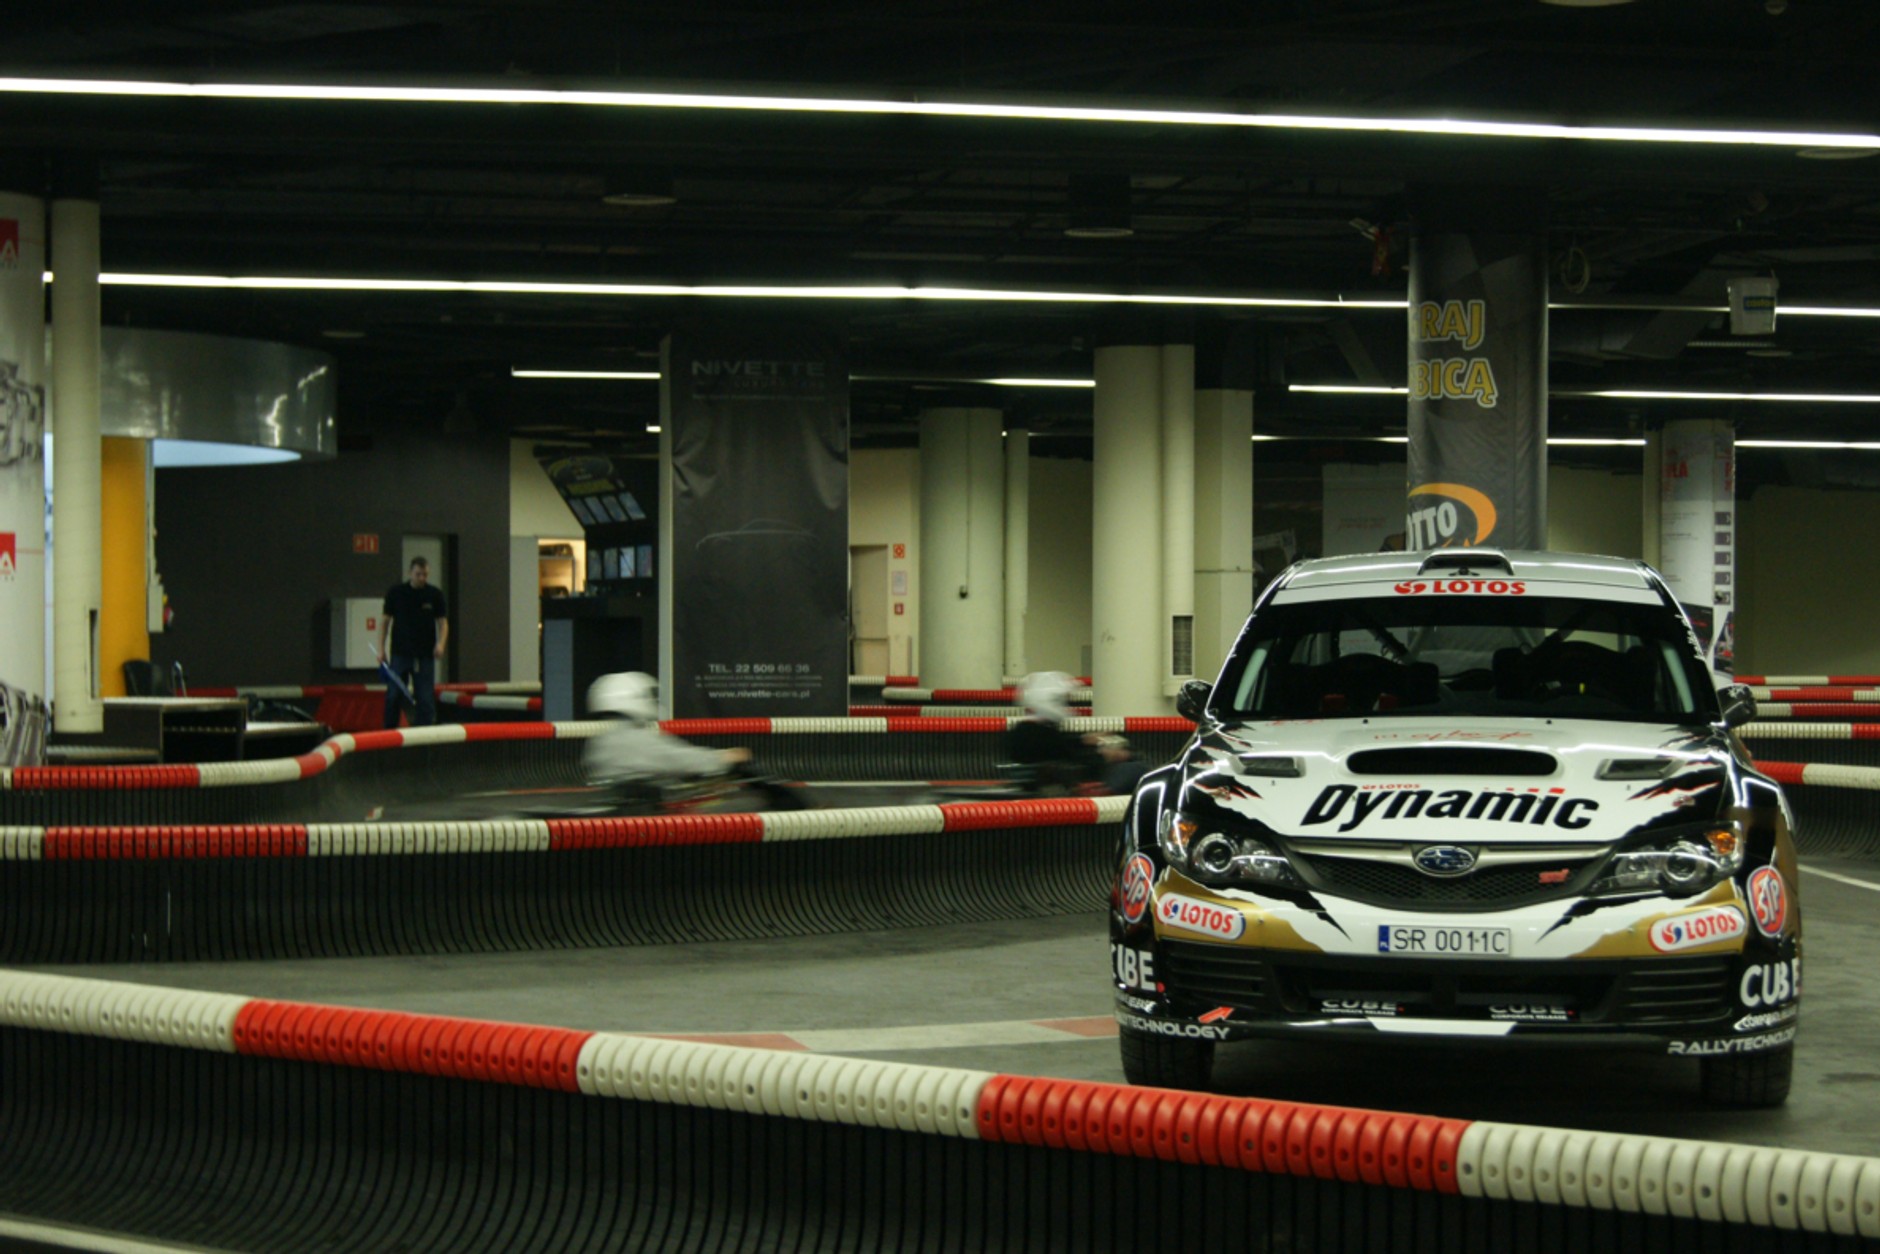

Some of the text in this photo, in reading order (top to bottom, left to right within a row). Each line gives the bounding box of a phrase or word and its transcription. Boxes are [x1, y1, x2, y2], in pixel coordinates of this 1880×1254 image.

[691, 360, 826, 377] NIVETTE
[1409, 358, 1498, 408] BICĄ
[1433, 580, 1526, 595] LOTOS
[735, 663, 750, 673] 22
[752, 663, 775, 673] 509
[1300, 784, 1599, 832] Dynamic
[1757, 874, 1779, 925] STP
[1180, 903, 1234, 934] LOTOS
[1685, 912, 1738, 941] LOTOS
[1394, 929, 1505, 952] SR 0011C
